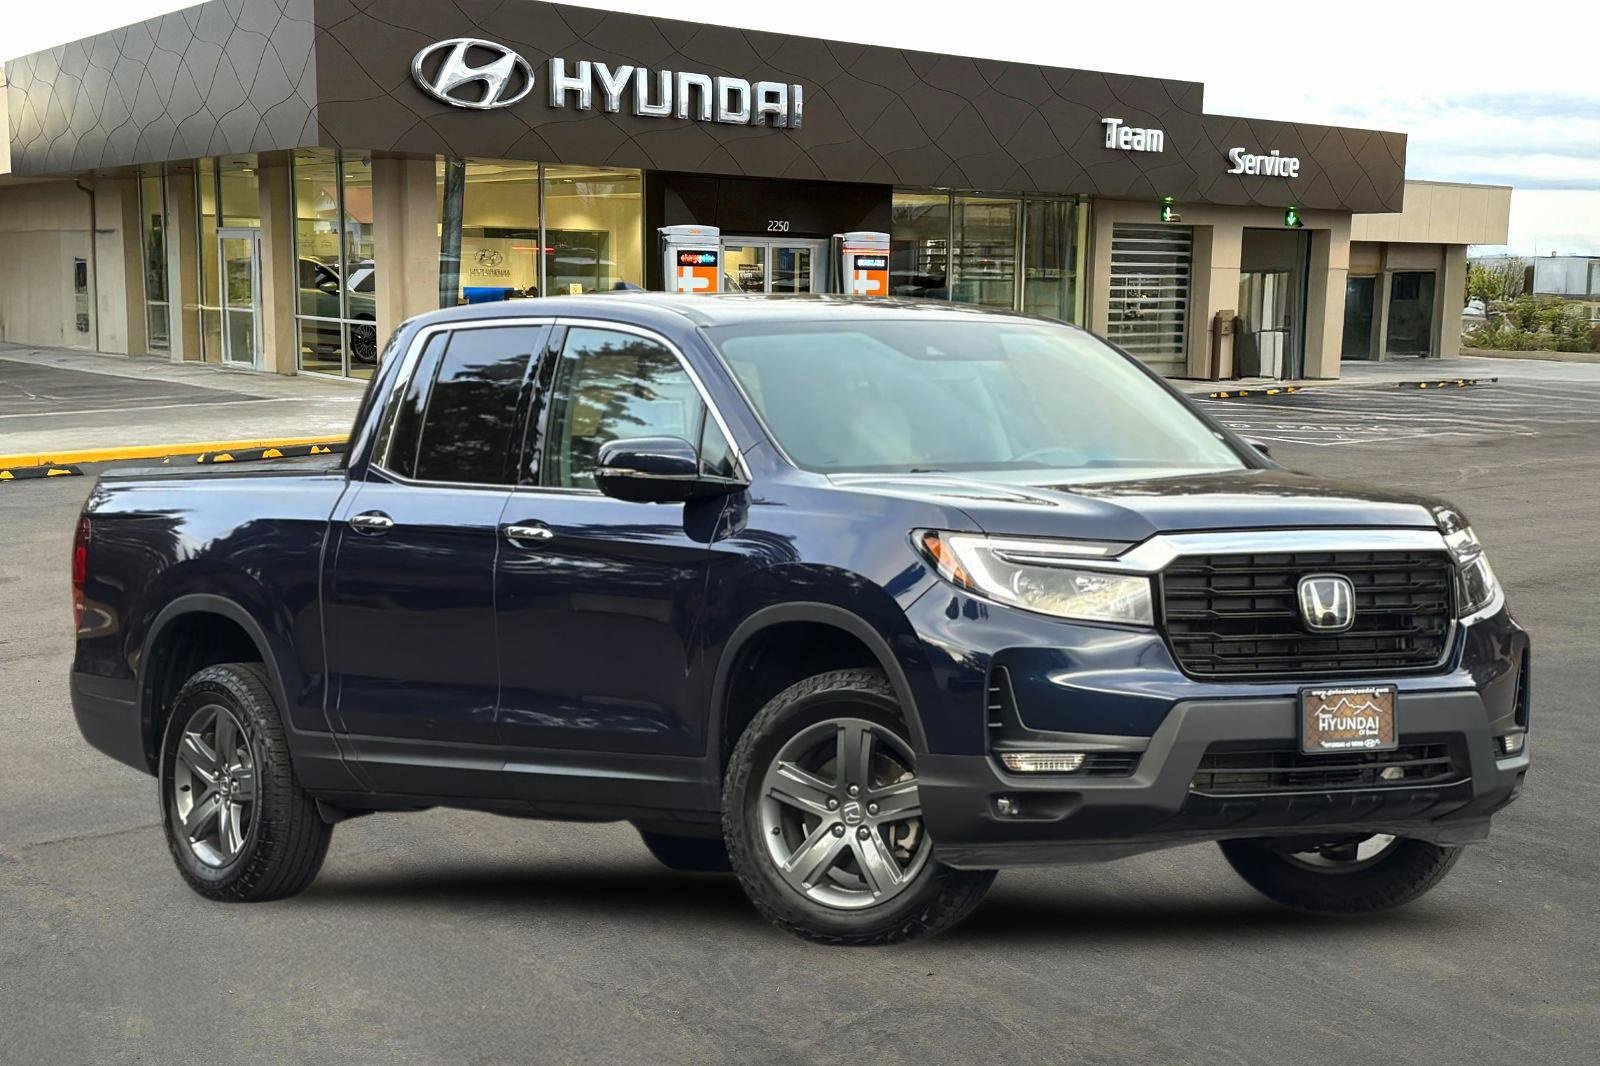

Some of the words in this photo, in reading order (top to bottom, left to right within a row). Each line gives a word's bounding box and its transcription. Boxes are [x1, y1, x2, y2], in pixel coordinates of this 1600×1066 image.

[549, 57, 802, 129] HYUNDAI
[1101, 117, 1164, 152] Team
[1227, 147, 1300, 177] Service
[767, 220, 790, 232] 2250
[1319, 716, 1379, 731] HYUNDAI
